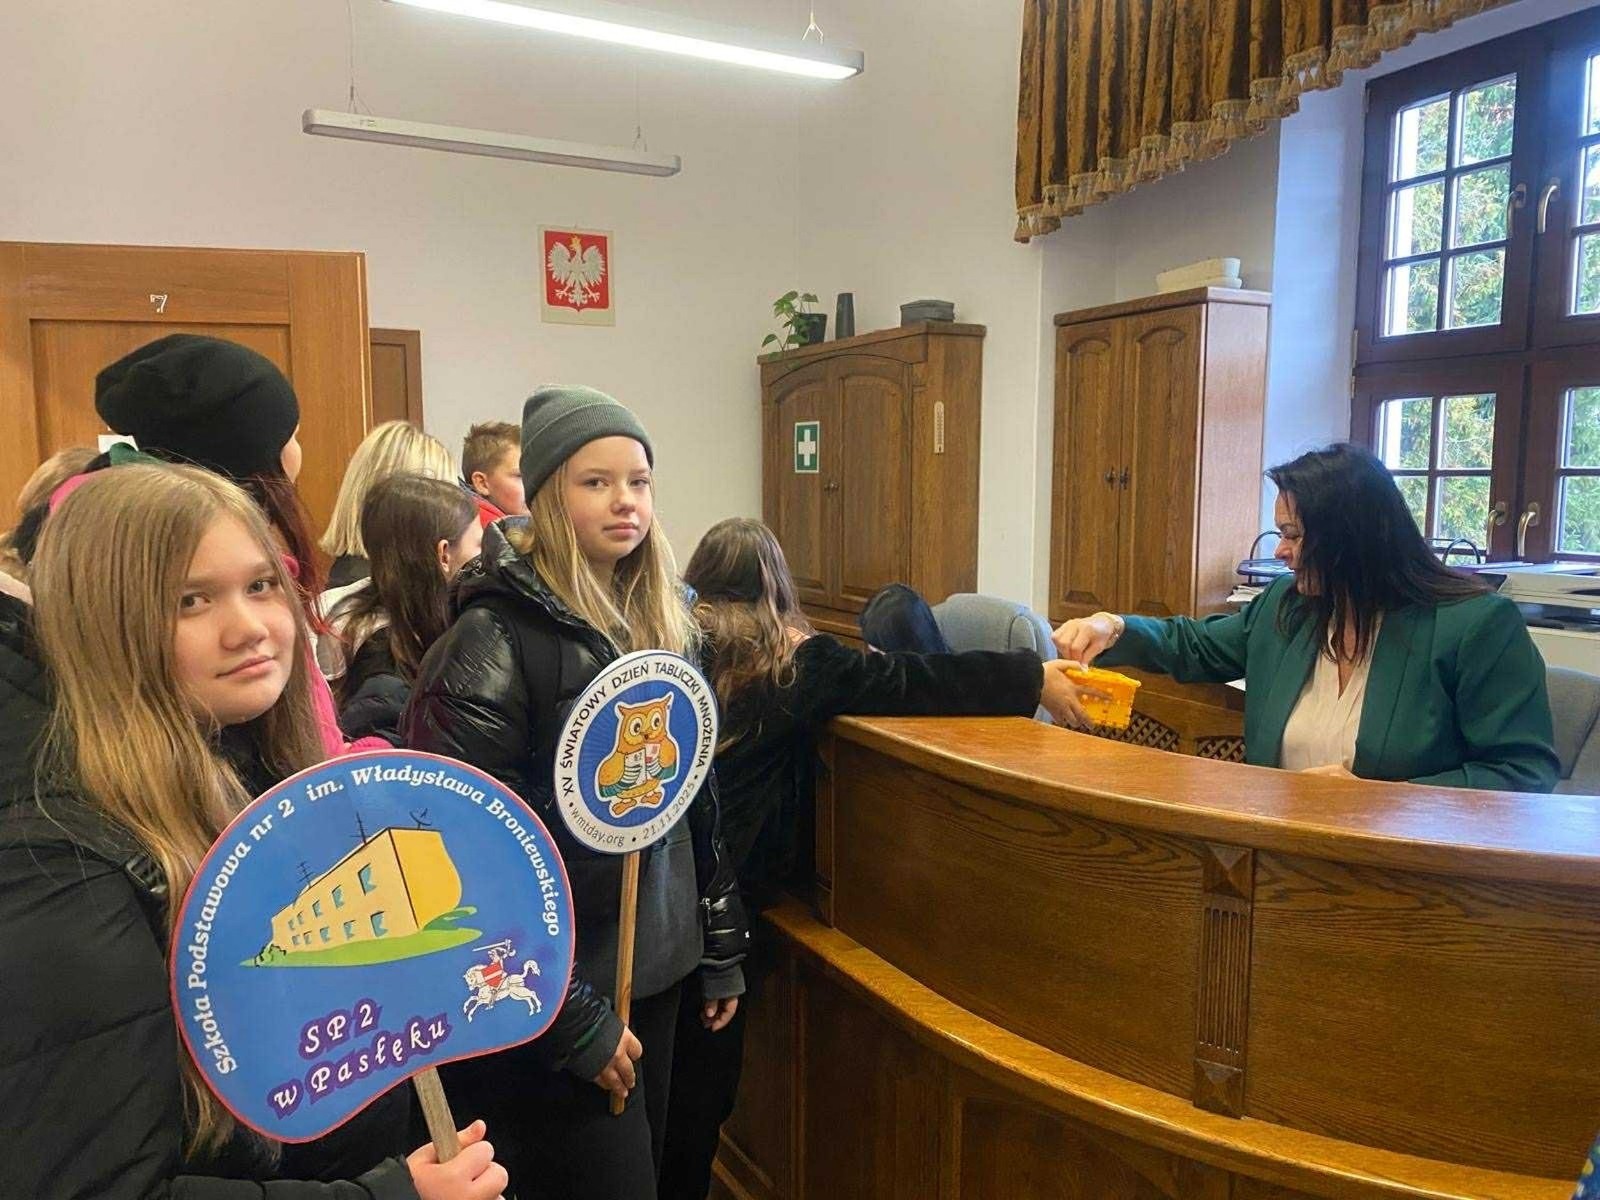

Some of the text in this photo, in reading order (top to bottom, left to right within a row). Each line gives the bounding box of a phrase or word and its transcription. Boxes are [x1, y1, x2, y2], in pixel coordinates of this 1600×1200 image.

[150, 294, 168, 313] 7
[560, 661, 714, 797] XV ŚWIATOWY DZIEŃ TABLICZKI MNOŻENIA
[571, 782, 695, 847] wmtday.org 21.11.2025
[188, 764, 560, 1075] Szkoła Podstawowa nr 2 im. Władysława Broniewskiego
[273, 1020, 446, 1109] w Pasłęku
[305, 1003, 374, 1053] SP 2
